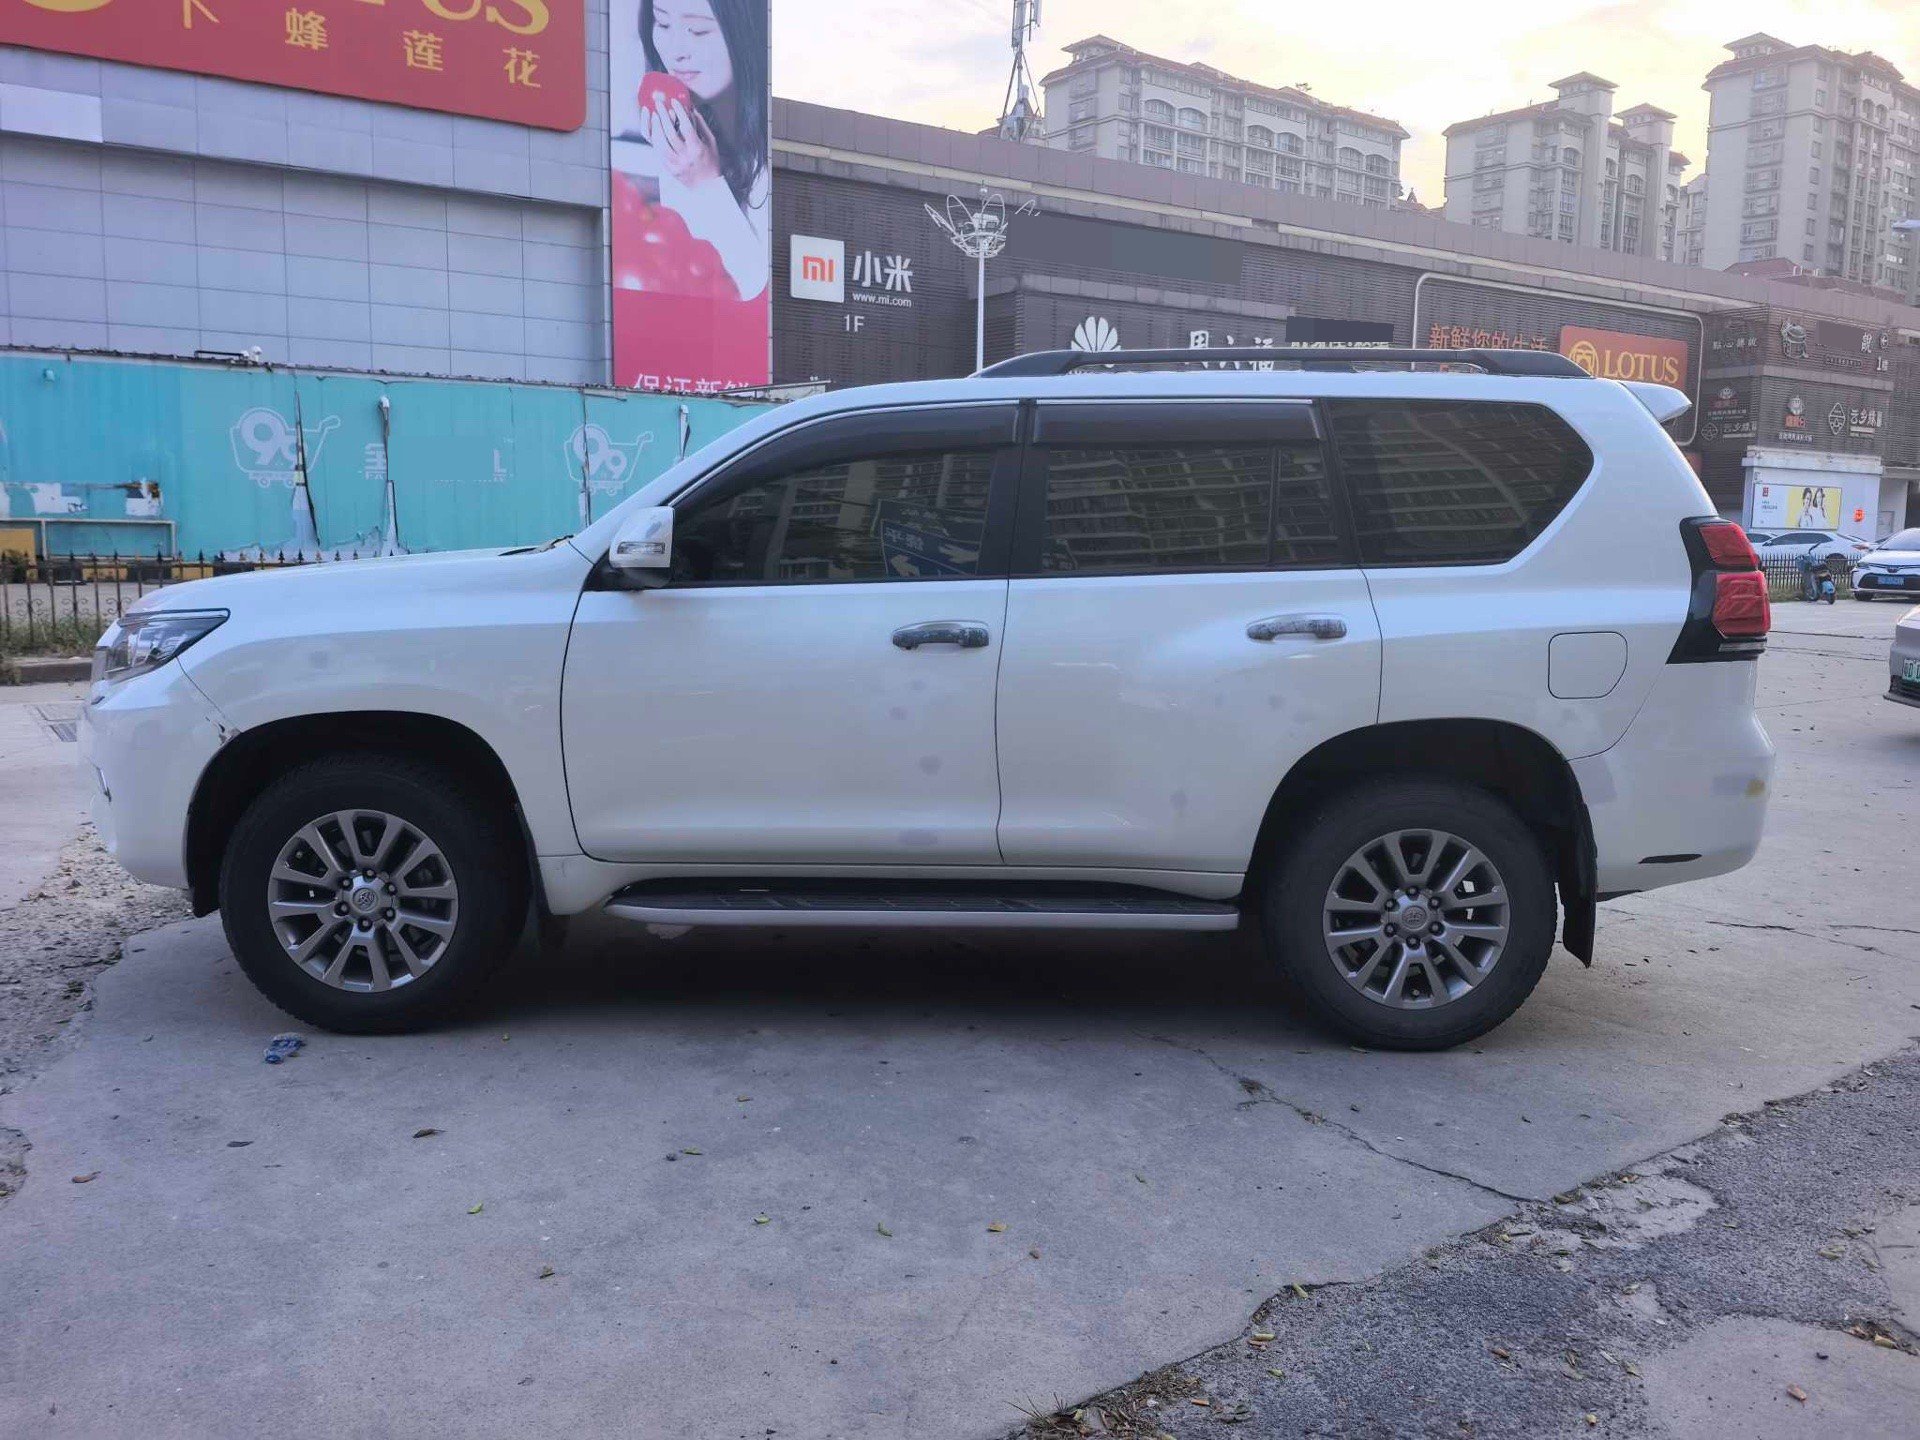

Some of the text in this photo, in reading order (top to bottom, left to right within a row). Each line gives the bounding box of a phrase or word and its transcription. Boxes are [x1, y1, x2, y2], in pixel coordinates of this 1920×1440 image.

[852, 250, 913, 293] 小米
[852, 292, 912, 308] www.mi.com
[843, 314, 865, 332] 1F
[1604, 349, 1679, 384] LOTUS
